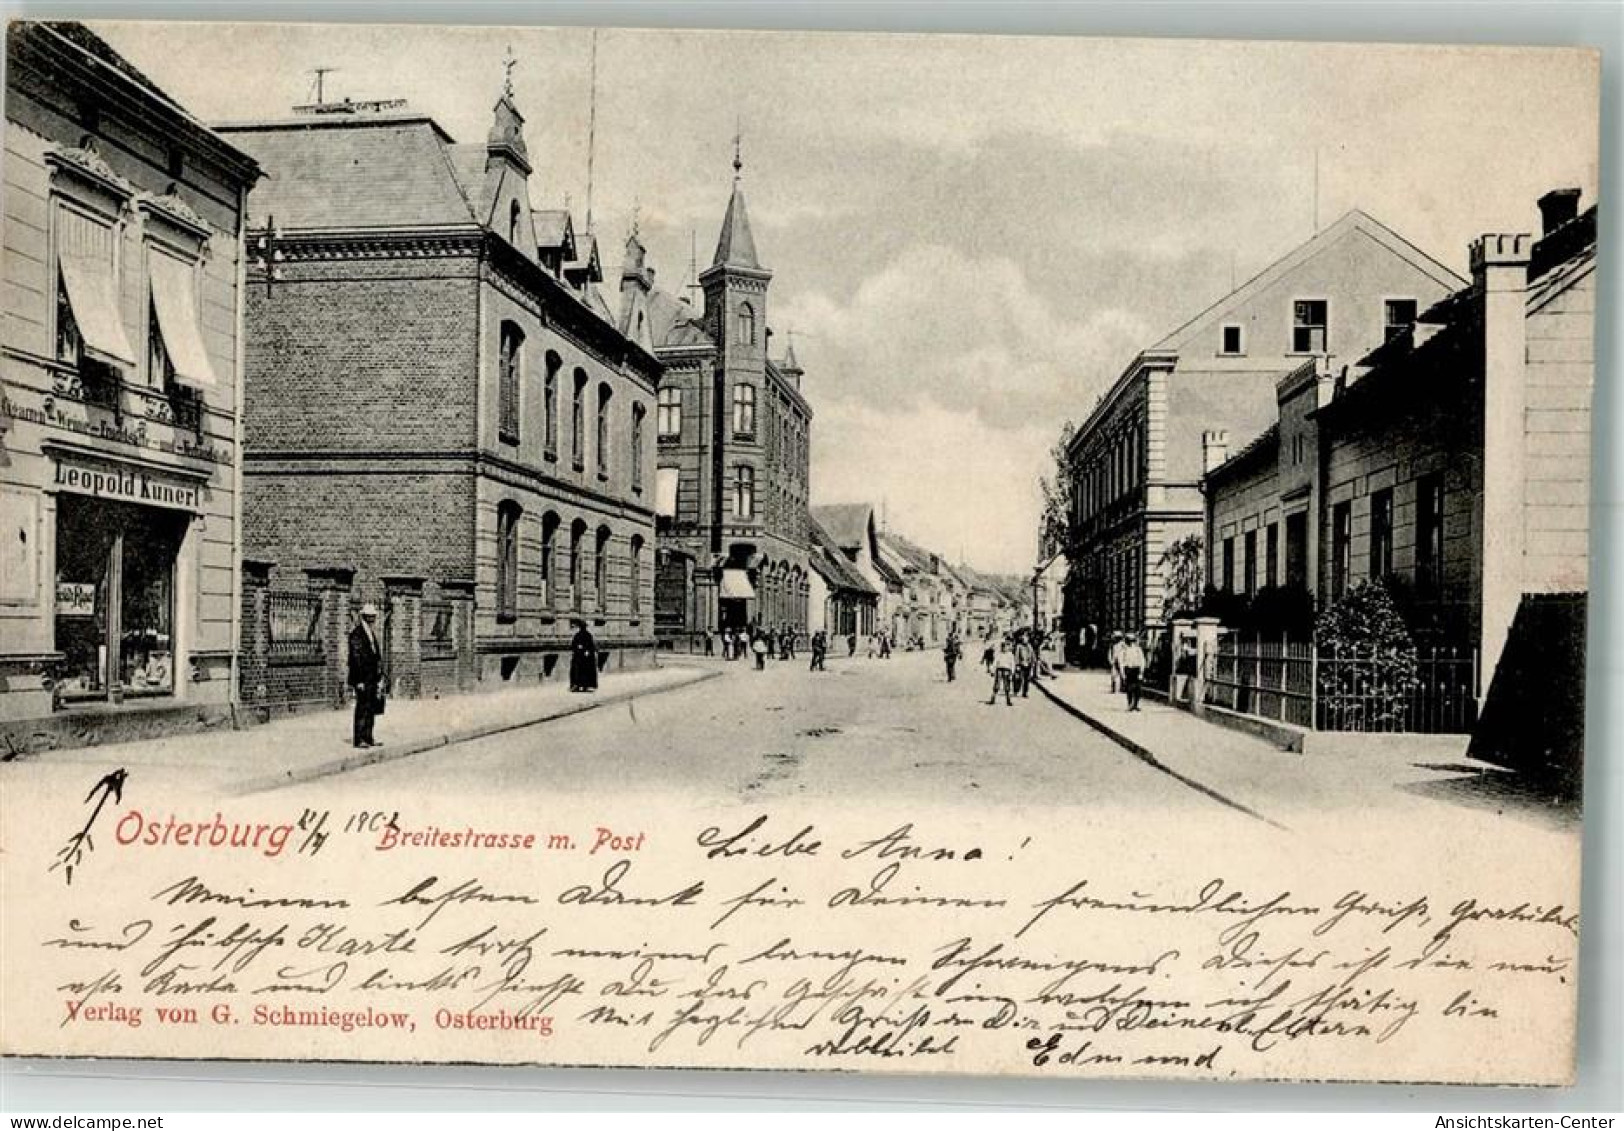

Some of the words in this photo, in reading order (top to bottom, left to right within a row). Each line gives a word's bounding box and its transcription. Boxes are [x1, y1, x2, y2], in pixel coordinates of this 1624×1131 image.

[54, 458, 135, 496] Leopold
[115, 811, 294, 857] Osterburg
[375, 824, 535, 850] Breitestrasse
[547, 832, 576, 850] m.
[589, 827, 646, 855] Post
[697, 815, 821, 859] Liebe
[841, 823, 983, 861] Anna
[150, 876, 350, 908] Meinen
[376, 876, 540, 931] besten
[557, 859, 704, 905] Dank
[701, 877, 805, 930] für
[828, 861, 1008, 907] Deinen
[1013, 879, 1320, 946] freundlichen
[42, 919, 153, 950] und
[297, 922, 416, 956] Karte
[737, 937, 907, 990] langen
[251, 960, 350, 994] und
[66, 1001, 142, 1027] Verlag
[155, 1007, 197, 1025] von
[211, 1004, 239, 1026] G.
[252, 1005, 416, 1033] Schmiegelow,
[435, 1007, 554, 1036] Osterburg
